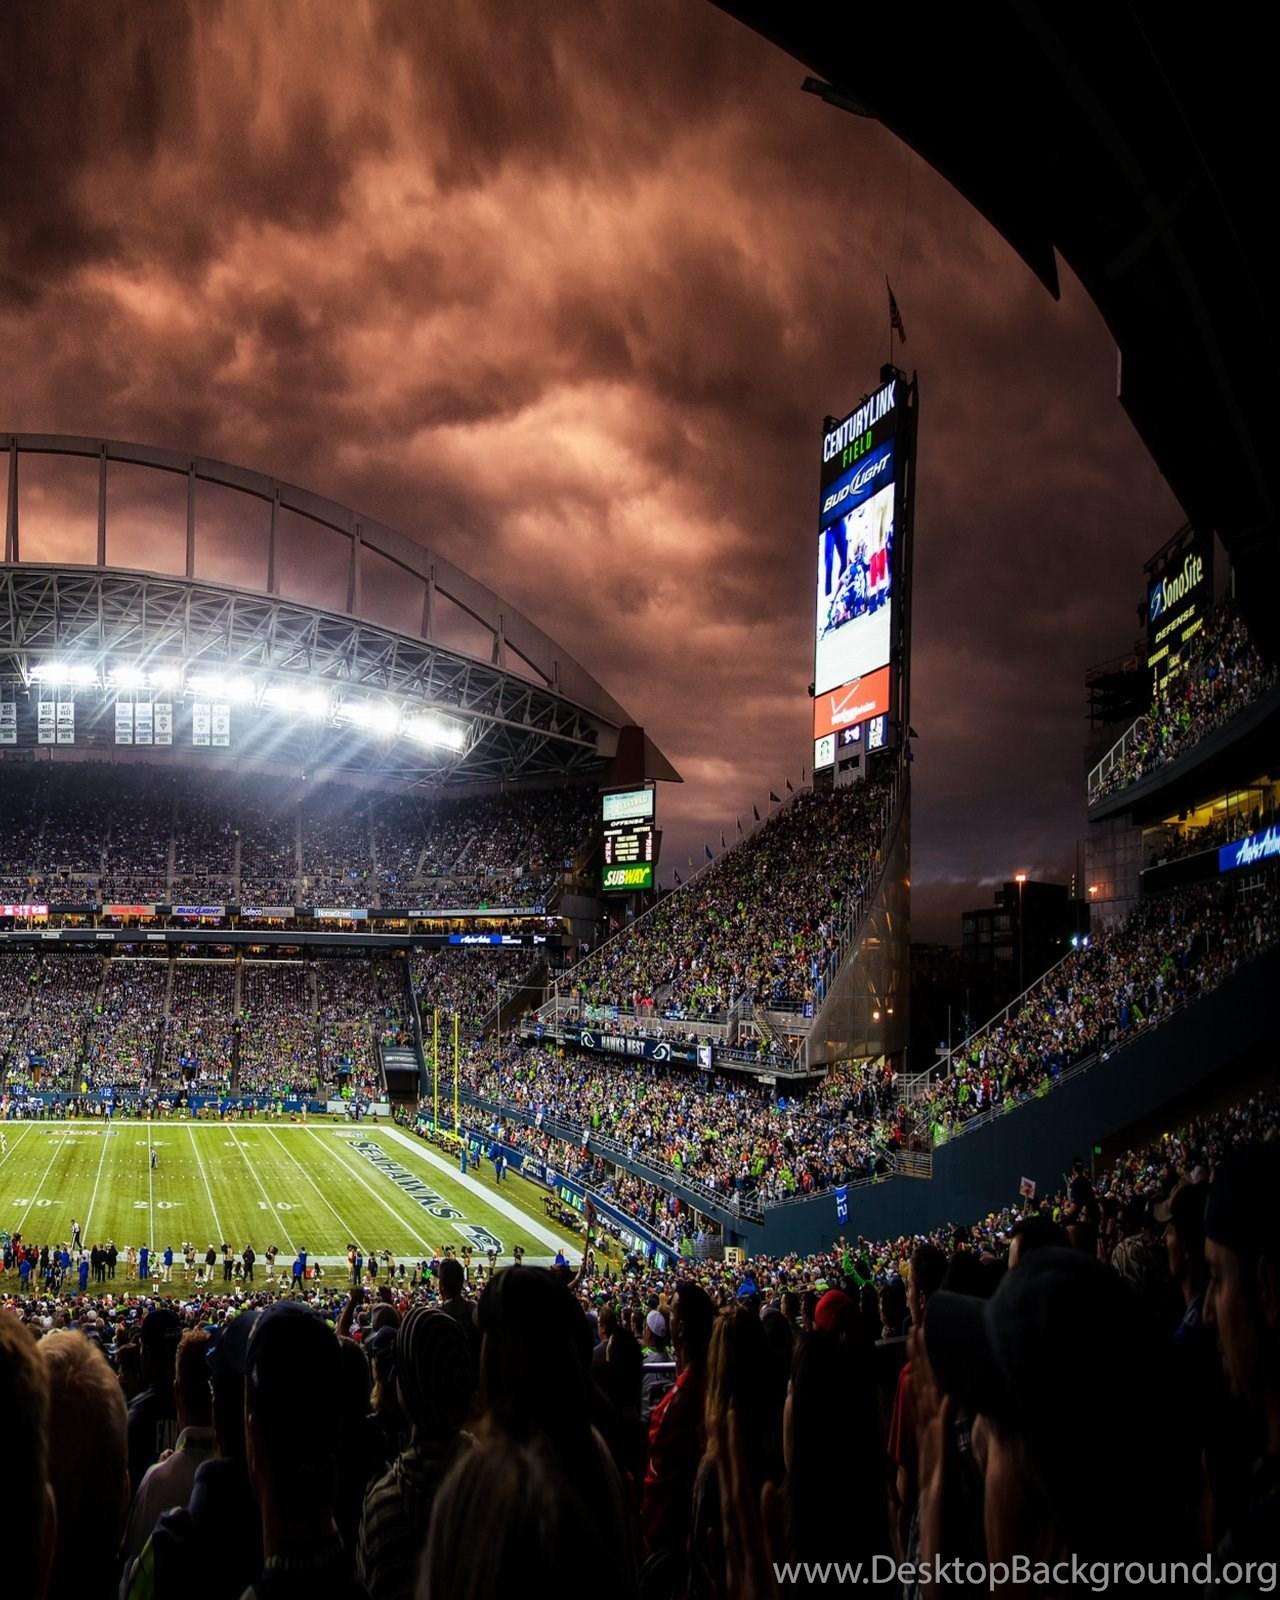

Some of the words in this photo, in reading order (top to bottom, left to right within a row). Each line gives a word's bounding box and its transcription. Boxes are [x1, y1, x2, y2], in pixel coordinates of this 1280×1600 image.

[823, 380, 896, 462] CENTURYLINK
[843, 430, 872, 468] FIELD
[823, 484, 849, 513] BUD
[854, 453, 891, 490] LIGHT
[1161, 553, 1204, 613] SonoSite
[1155, 604, 1196, 643] DEFENSE
[610, 818, 644, 827] OFFENSE
[604, 867, 651, 887] SUBWAY
[176, 906, 195, 914] BUD
[242, 907, 262, 916] Safeco
[601, 1036, 626, 1052] HAWKS
[627, 1039, 645, 1055] NEST
[16, 1087, 24, 1095] 12
[104, 1088, 112, 1096] 12
[347, 1140, 466, 1220] SEAHAWKS
[12, 1198, 52, 1207] 30
[133, 1200, 174, 1210] 20
[257, 1200, 293, 1211] 10
[836, 1194, 848, 1217] 12
